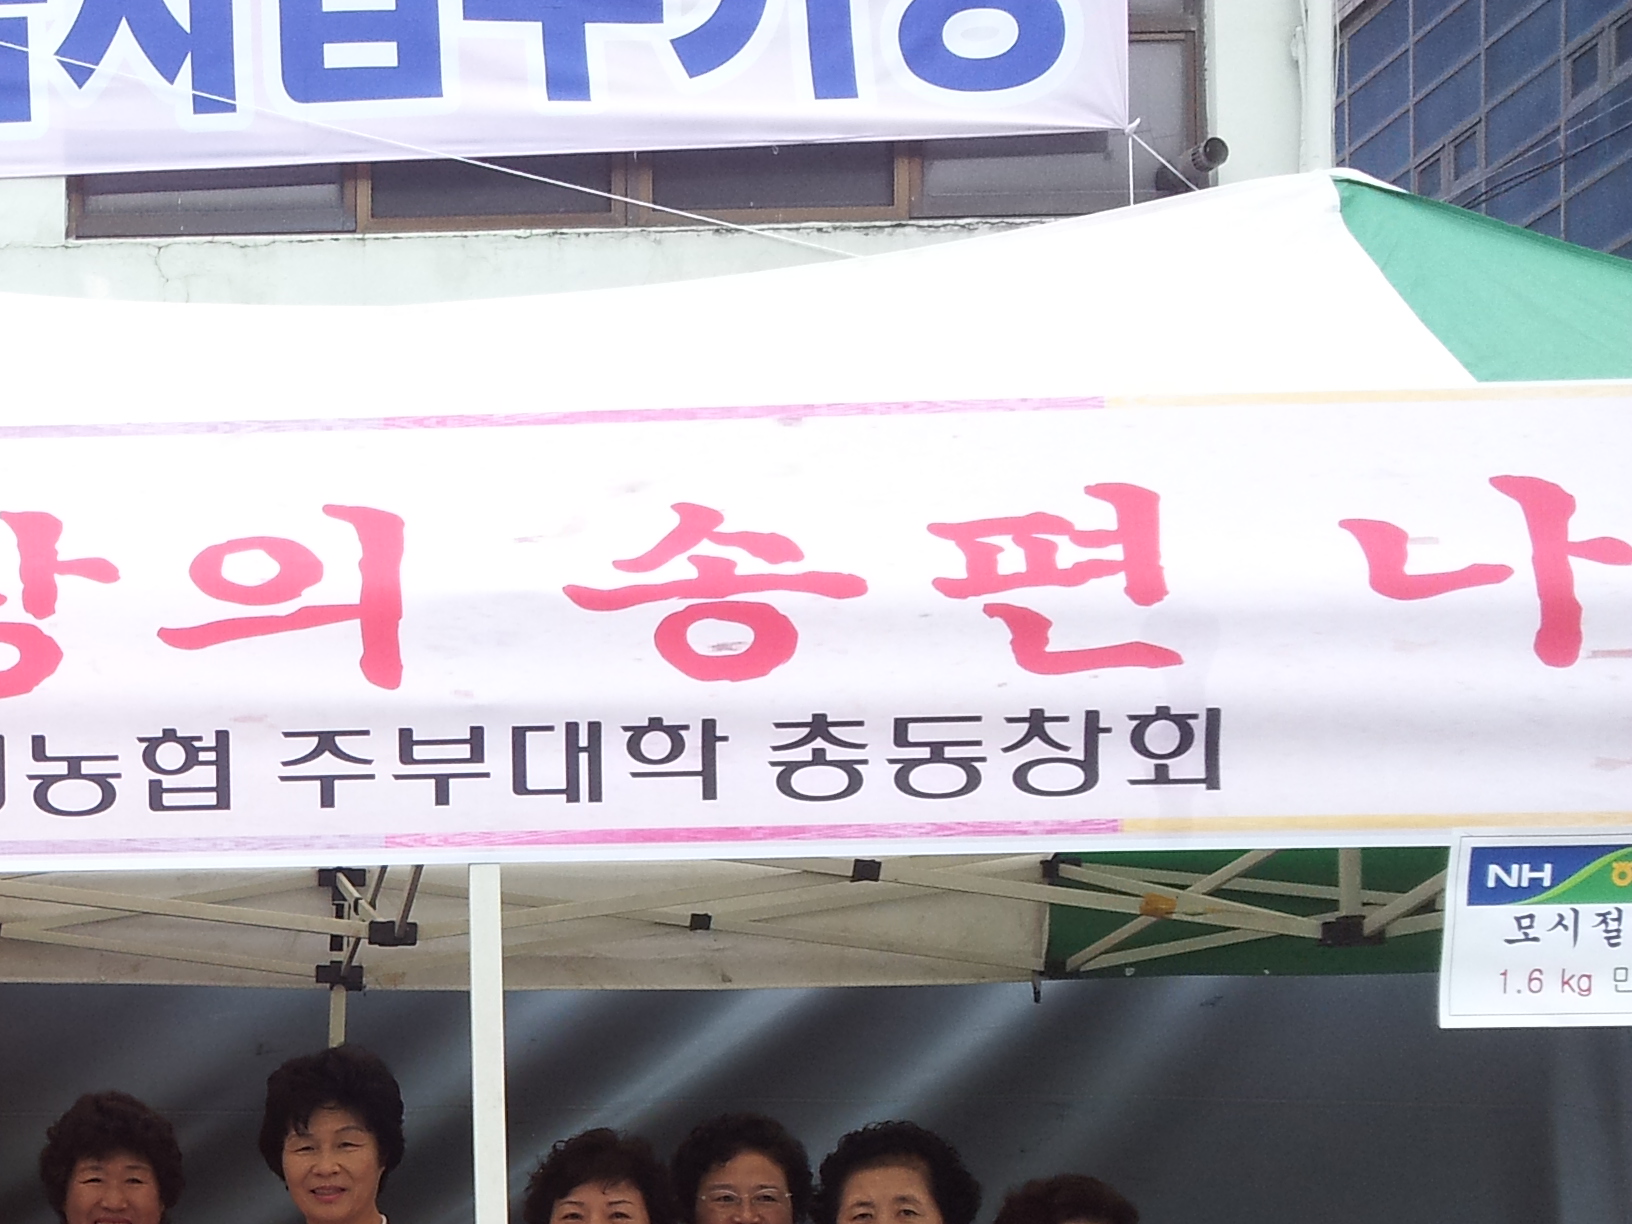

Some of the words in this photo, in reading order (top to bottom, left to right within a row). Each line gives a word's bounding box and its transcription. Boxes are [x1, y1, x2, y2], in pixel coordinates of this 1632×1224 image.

[563, 483, 1183, 682] 송편
[1339, 475, 1632, 668] 나
[278, 717, 729, 808] 주부대학
[768, 706, 1221, 801] 총동창회
[1487, 863, 1552, 888] NH
[1500, 969, 1543, 993] 1.6
[1562, 969, 1592, 997] kg
